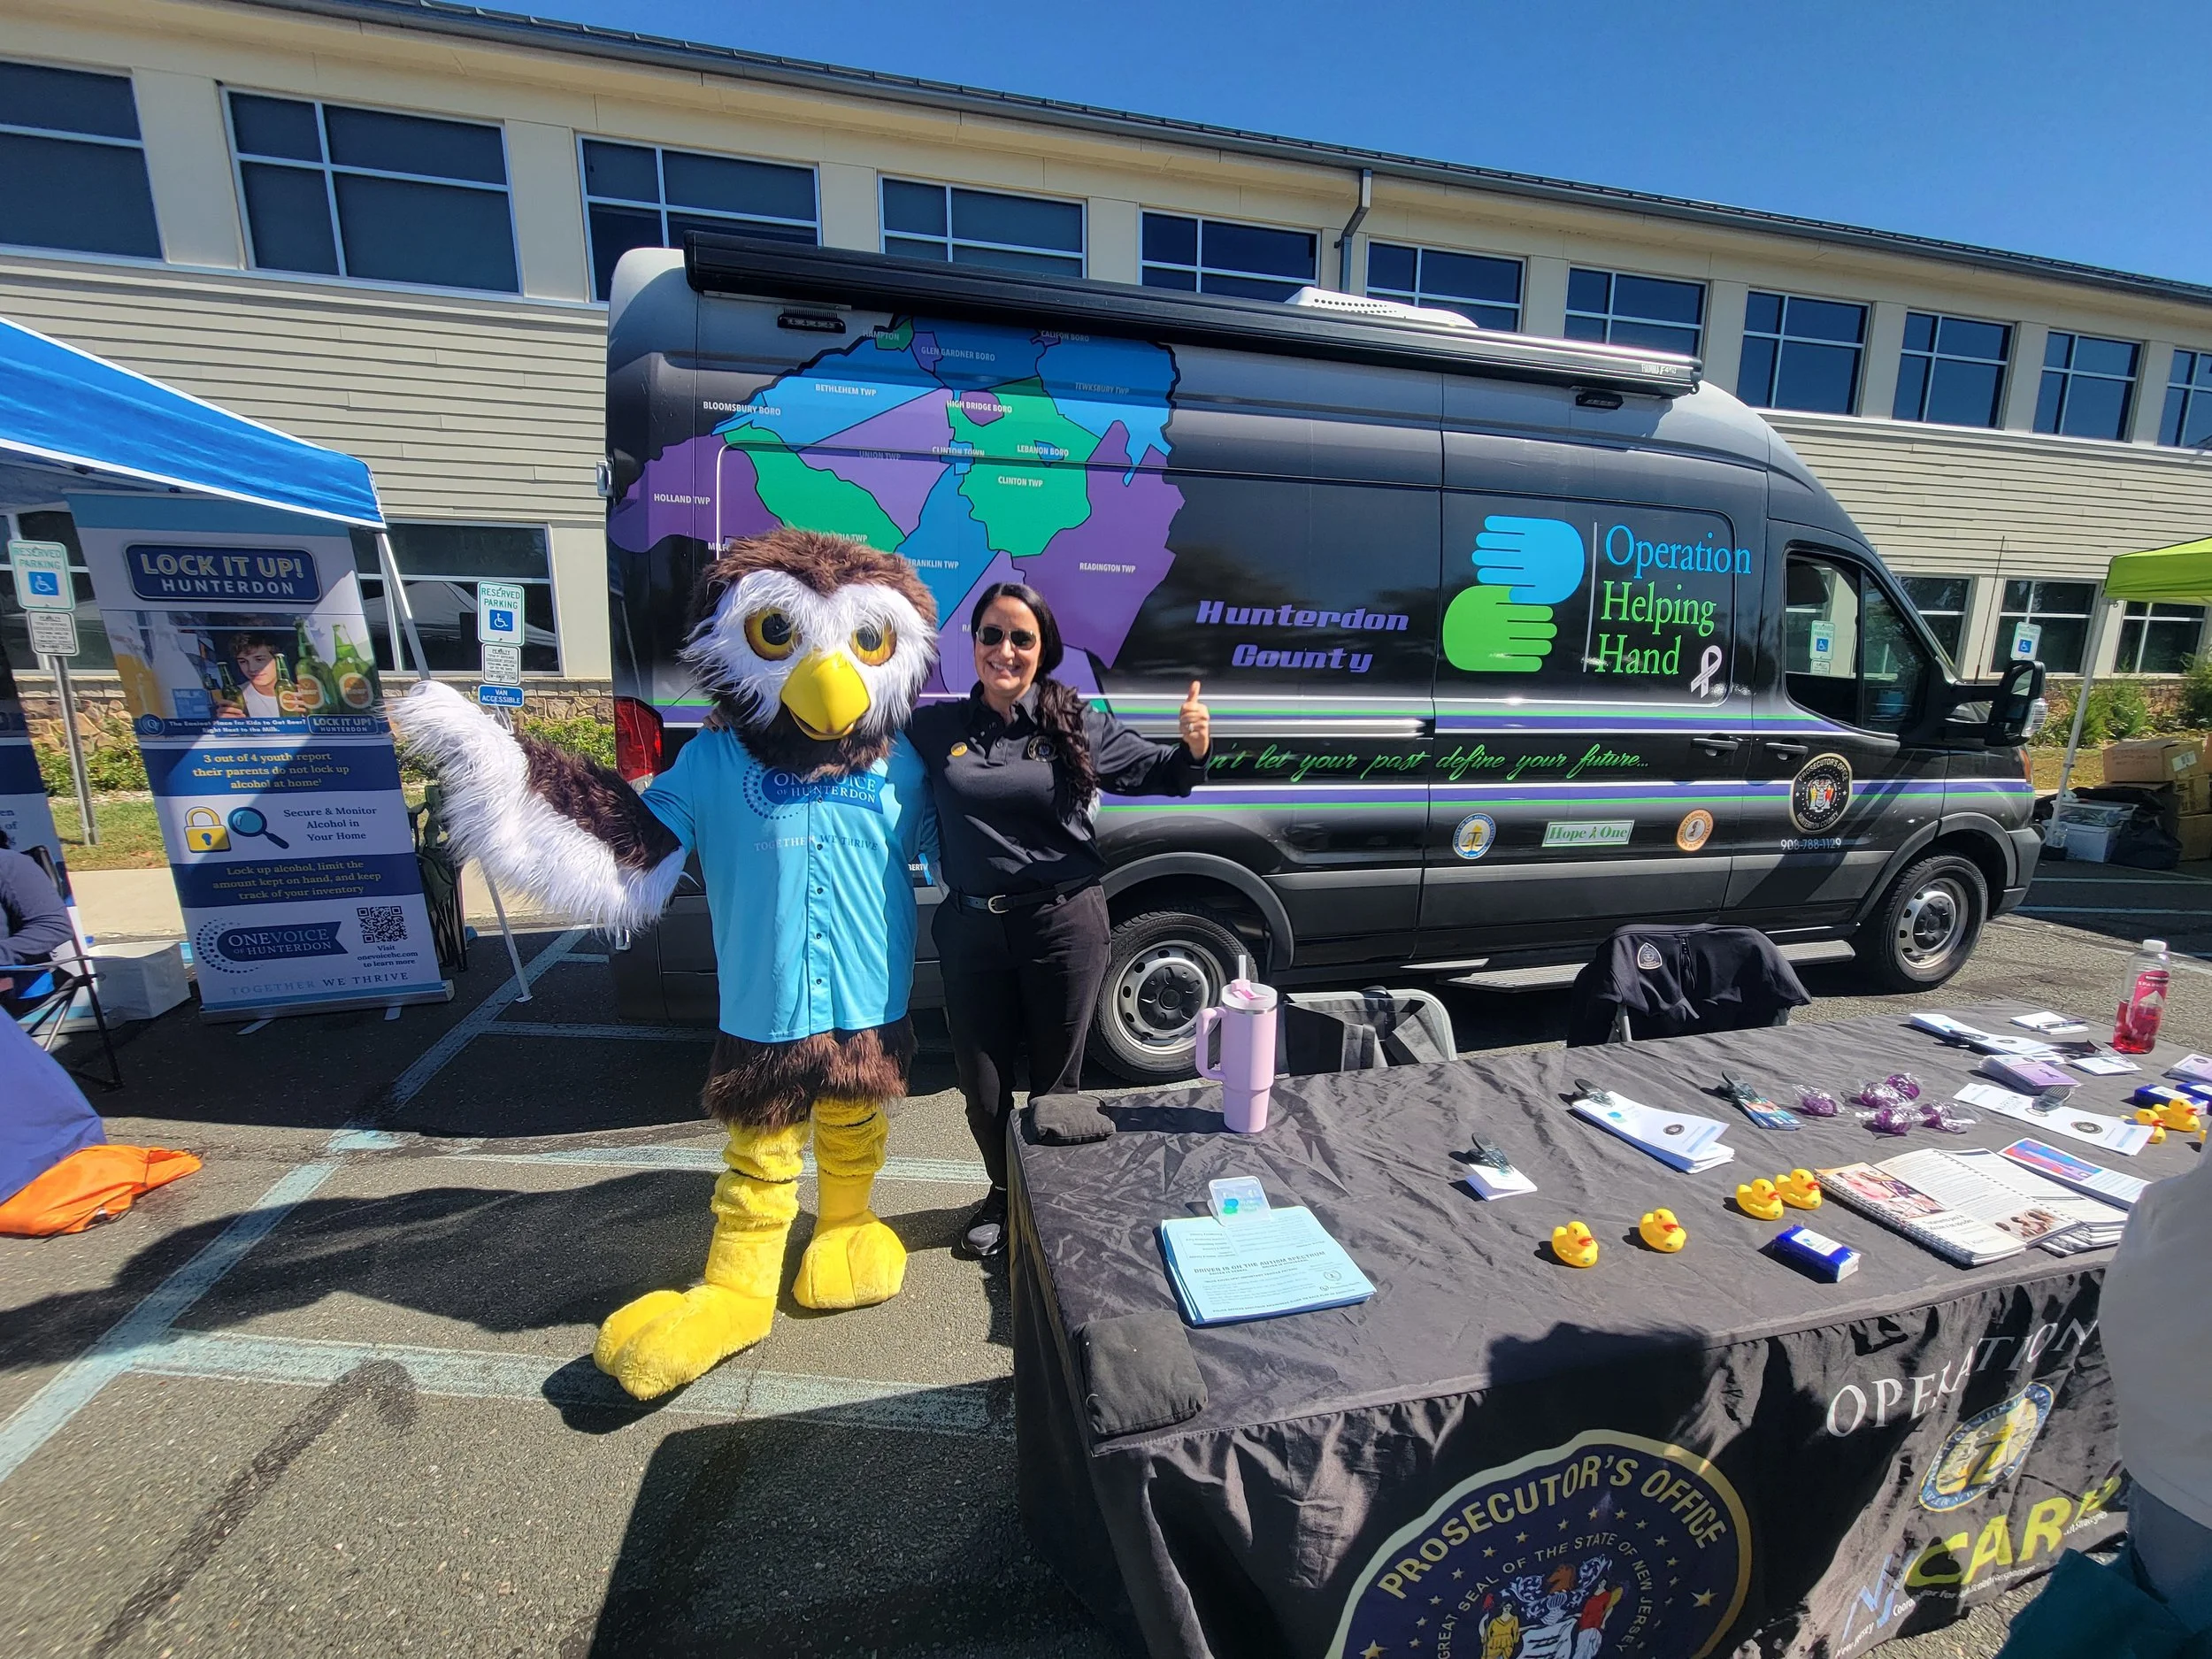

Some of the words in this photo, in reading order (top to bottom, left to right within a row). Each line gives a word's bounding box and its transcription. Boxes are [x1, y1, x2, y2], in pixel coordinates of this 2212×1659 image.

[863, 329, 900, 341] HAMPTON
[1041, 330, 1068, 340] CALIFON
[1071, 333, 1089, 342] BORO
[921, 346, 939, 356] GLEN
[941, 348, 974, 359] GARDNER
[975, 351, 995, 361] BORO
[815, 383, 858, 396] BETHLEHEM
[860, 387, 877, 396] TWP
[1075, 381, 1113, 393] TEWKSBURY
[1115, 386, 1130, 395] TWP
[703, 401, 757, 414] BLOOMSBURY
[758, 405, 781, 416] BORO
[947, 399, 964, 408] HIGH
[966, 401, 991, 411] BRIDGE
[993, 404, 1012, 413] BORO
[859, 449, 883, 460] UNION
[885, 452, 901, 461] TWP
[933, 446, 962, 455] CLINTON
[964, 448, 985, 457] TOWN
[1017, 444, 1048, 456] LEBANON
[1050, 447, 1069, 457] BORO
[997, 476, 1026, 486] CLINTON
[1027, 478, 1043, 488] TWP
[654, 493, 691, 504] HOLLAND
[694, 495, 710, 505] TWP
[1605, 524, 1753, 580] Operation
[141, 553, 219, 577] LOCK
[223, 556, 249, 578] IT
[257, 557, 304, 580] UP!
[944, 560, 959, 569] TWP
[1079, 562, 1120, 572] READINGTON
[1122, 565, 1136, 573] TWP
[163, 579, 295, 595] HUNTERDON
[481, 587, 521, 600] RESERVED
[484, 598, 518, 609] PARKING
[1601, 580, 1717, 638] Helping
[1195, 600, 1409, 631] Hunterdon
[1232, 644, 1374, 673] County
[1594, 634, 1682, 675] Hand
[482, 695, 521, 704] ACCESSIBLE
[312, 718, 340, 726] LOCK
[341, 718, 352, 726] IT
[354, 718, 371, 726] UP!
[203, 754, 211, 763] 3
[237, 753, 249, 763] of
[260, 752, 293, 764] youth
[296, 752, 332, 764] report
[1208, 741, 1250, 770] n't
[1254, 743, 1295, 770] let
[1289, 754, 1359, 783] your
[1360, 749, 1431, 780] past
[1435, 744, 1505, 780] define
[1505, 752, 1566, 781] your
[192, 767, 223, 777] their
[226, 767, 270, 779] parents
[271, 767, 287, 776] do
[288, 766, 308, 775] not
[311, 764, 334, 774] lock
[336, 766, 349, 776] up
[1836, 761, 1849, 782] OFFICE
[230, 780, 271, 789] alcohol
[273, 780, 286, 788] at
[792, 786, 876, 803] HUNTERDON
[283, 809, 323, 818] Secure
[335, 806, 378, 816] Monitor
[1819, 810, 1839, 828] COUNTY
[306, 819, 347, 829] Alcohol
[306, 833, 334, 841] Your
[336, 831, 367, 841] Home
[1549, 824, 1587, 841] Hope
[1600, 824, 1628, 839] One
[754, 834, 815, 852] TOGETHER
[819, 834, 837, 843] WE
[841, 836, 879, 851] THRIVE
[1780, 837, 1842, 851] 908-788-1129
[226, 865, 255, 876] Lock
[257, 865, 272, 877] up
[273, 863, 316, 873] alcohol,
[318, 861, 344, 871] limit
[346, 860, 364, 869] the
[212, 879, 257, 889] amount
[258, 876, 285, 887] kept
[303, 874, 334, 885] hand,
[335, 873, 353, 882] and
[357, 872, 382, 883] keep
[239, 890, 269, 900] track
[272, 888, 282, 898] of
[283, 888, 310, 899] your
[311, 885, 365, 896] inventory
[227, 929, 329, 947] ONEVOICE
[248, 941, 332, 956] HUNTERDON
[357, 951, 419, 961] onevoicehc.com
[230, 980, 314, 995] TOGETHER
[322, 978, 346, 987] WE
[353, 972, 410, 985] THRIVE
[1259, 1257, 1287, 1266] AUTISM
[1287, 1250, 1325, 1263] SPECTRUM
[1377, 1454, 1640, 1600] PROSECUTOR'S
[1640, 1468, 1728, 1550] OFFICE
[1573, 1531, 1618, 1551] STATE
[1617, 1537, 1639, 1559] OF
[1534, 1541, 1569, 1563] THE
[1502, 1555, 1527, 1574] OF
[1633, 1558, 1654, 1592] NEW
[1457, 1574, 1500, 1613] SEAL
[1614, 1595, 1655, 1652] JERSEY
[1437, 1610, 1459, 1659] GREAT
